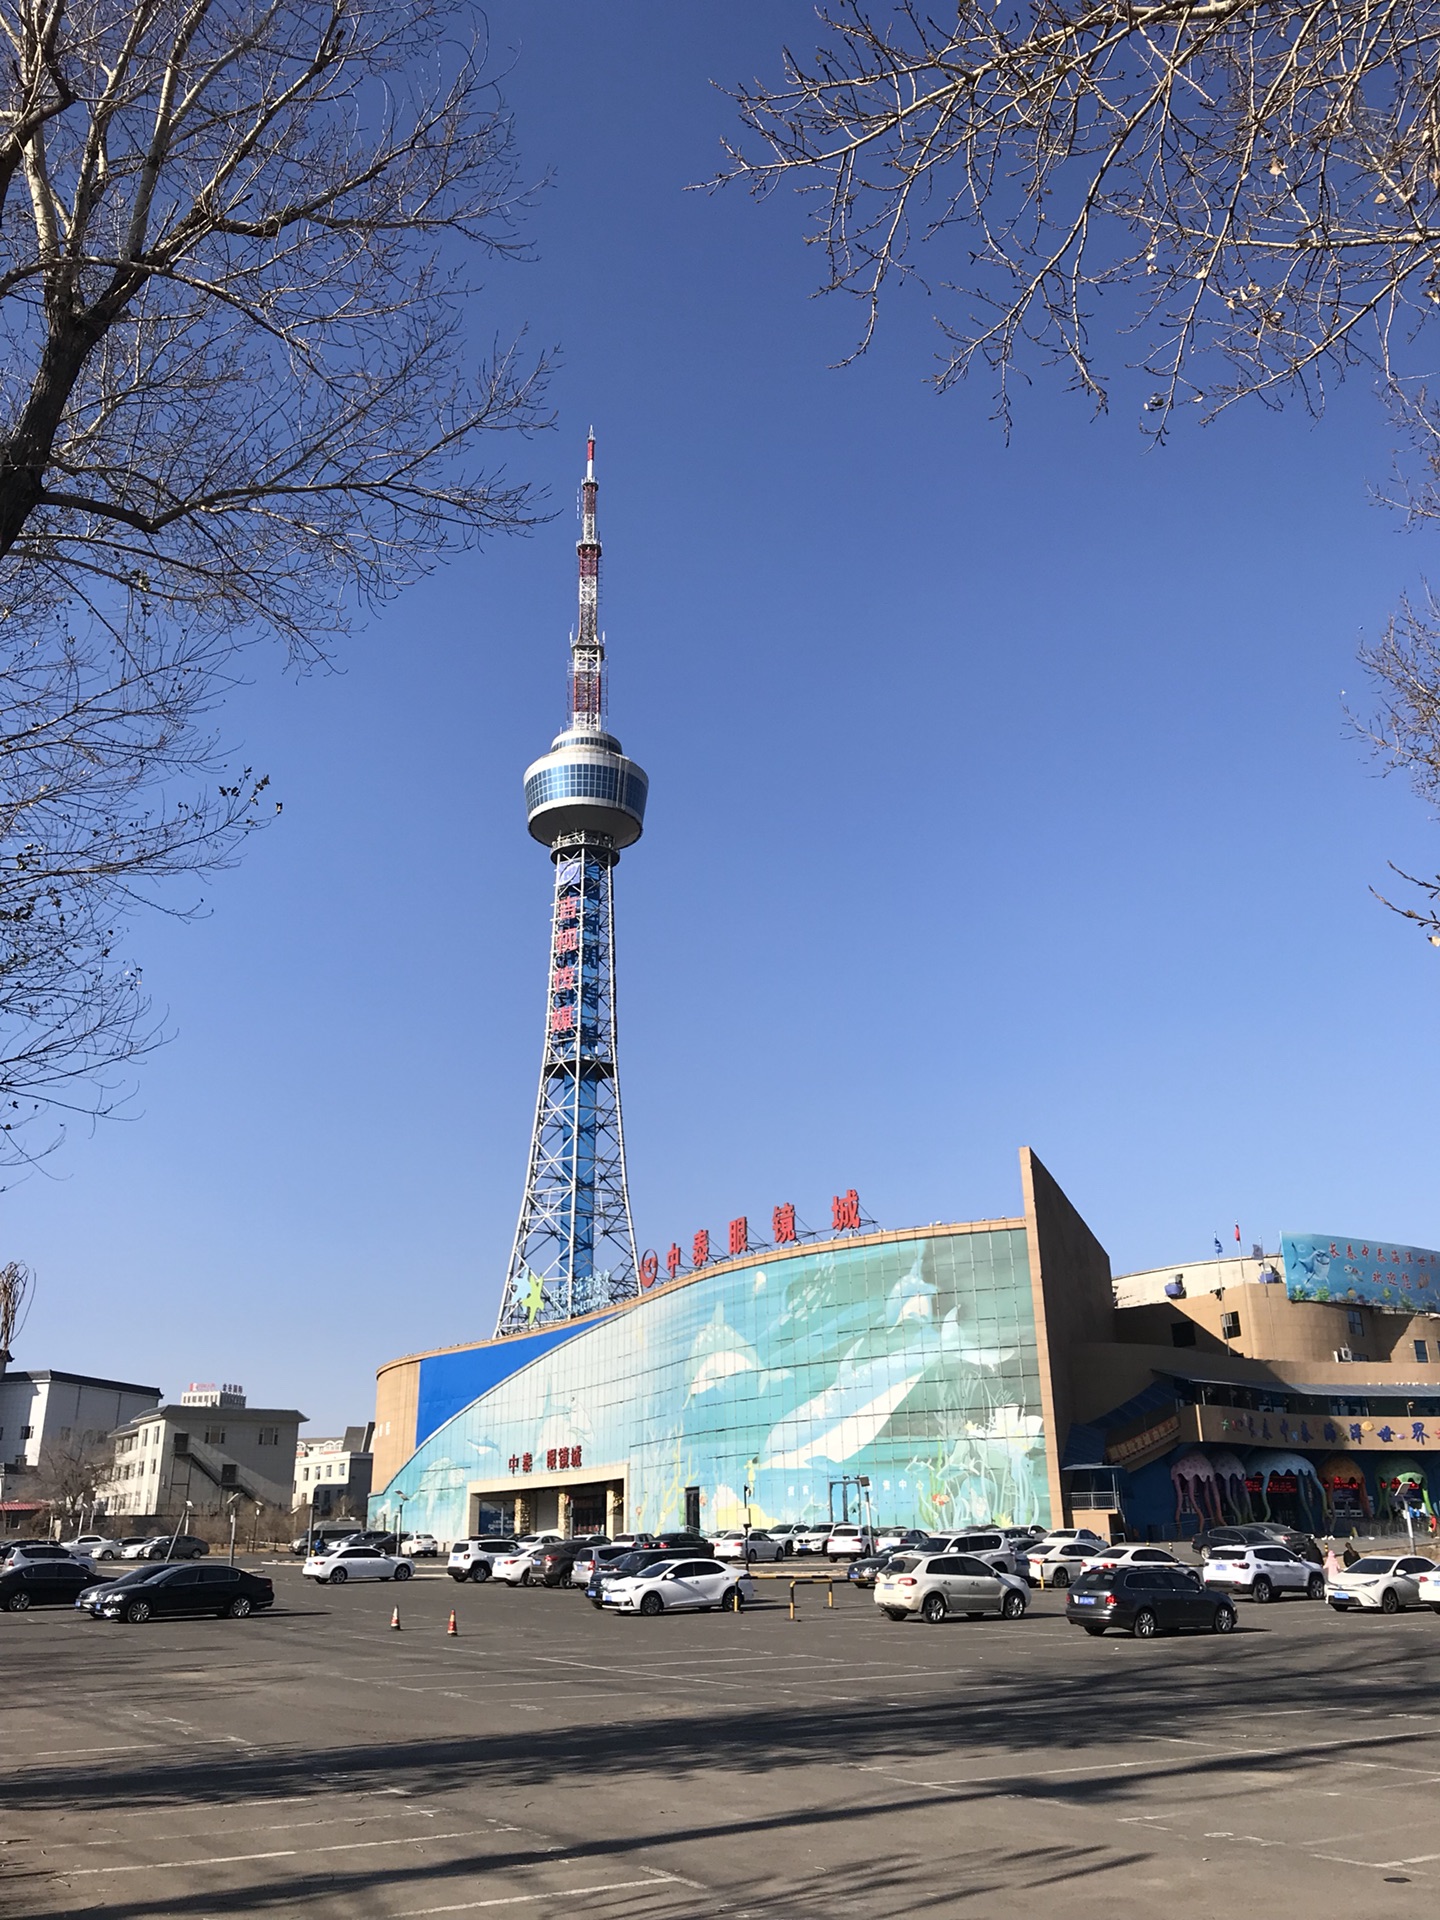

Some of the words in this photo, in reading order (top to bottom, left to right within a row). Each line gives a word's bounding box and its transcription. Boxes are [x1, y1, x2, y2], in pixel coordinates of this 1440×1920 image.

[550, 895, 580, 1033] 吉视传媒
[667, 1189, 861, 1278] 中泰眼镜城
